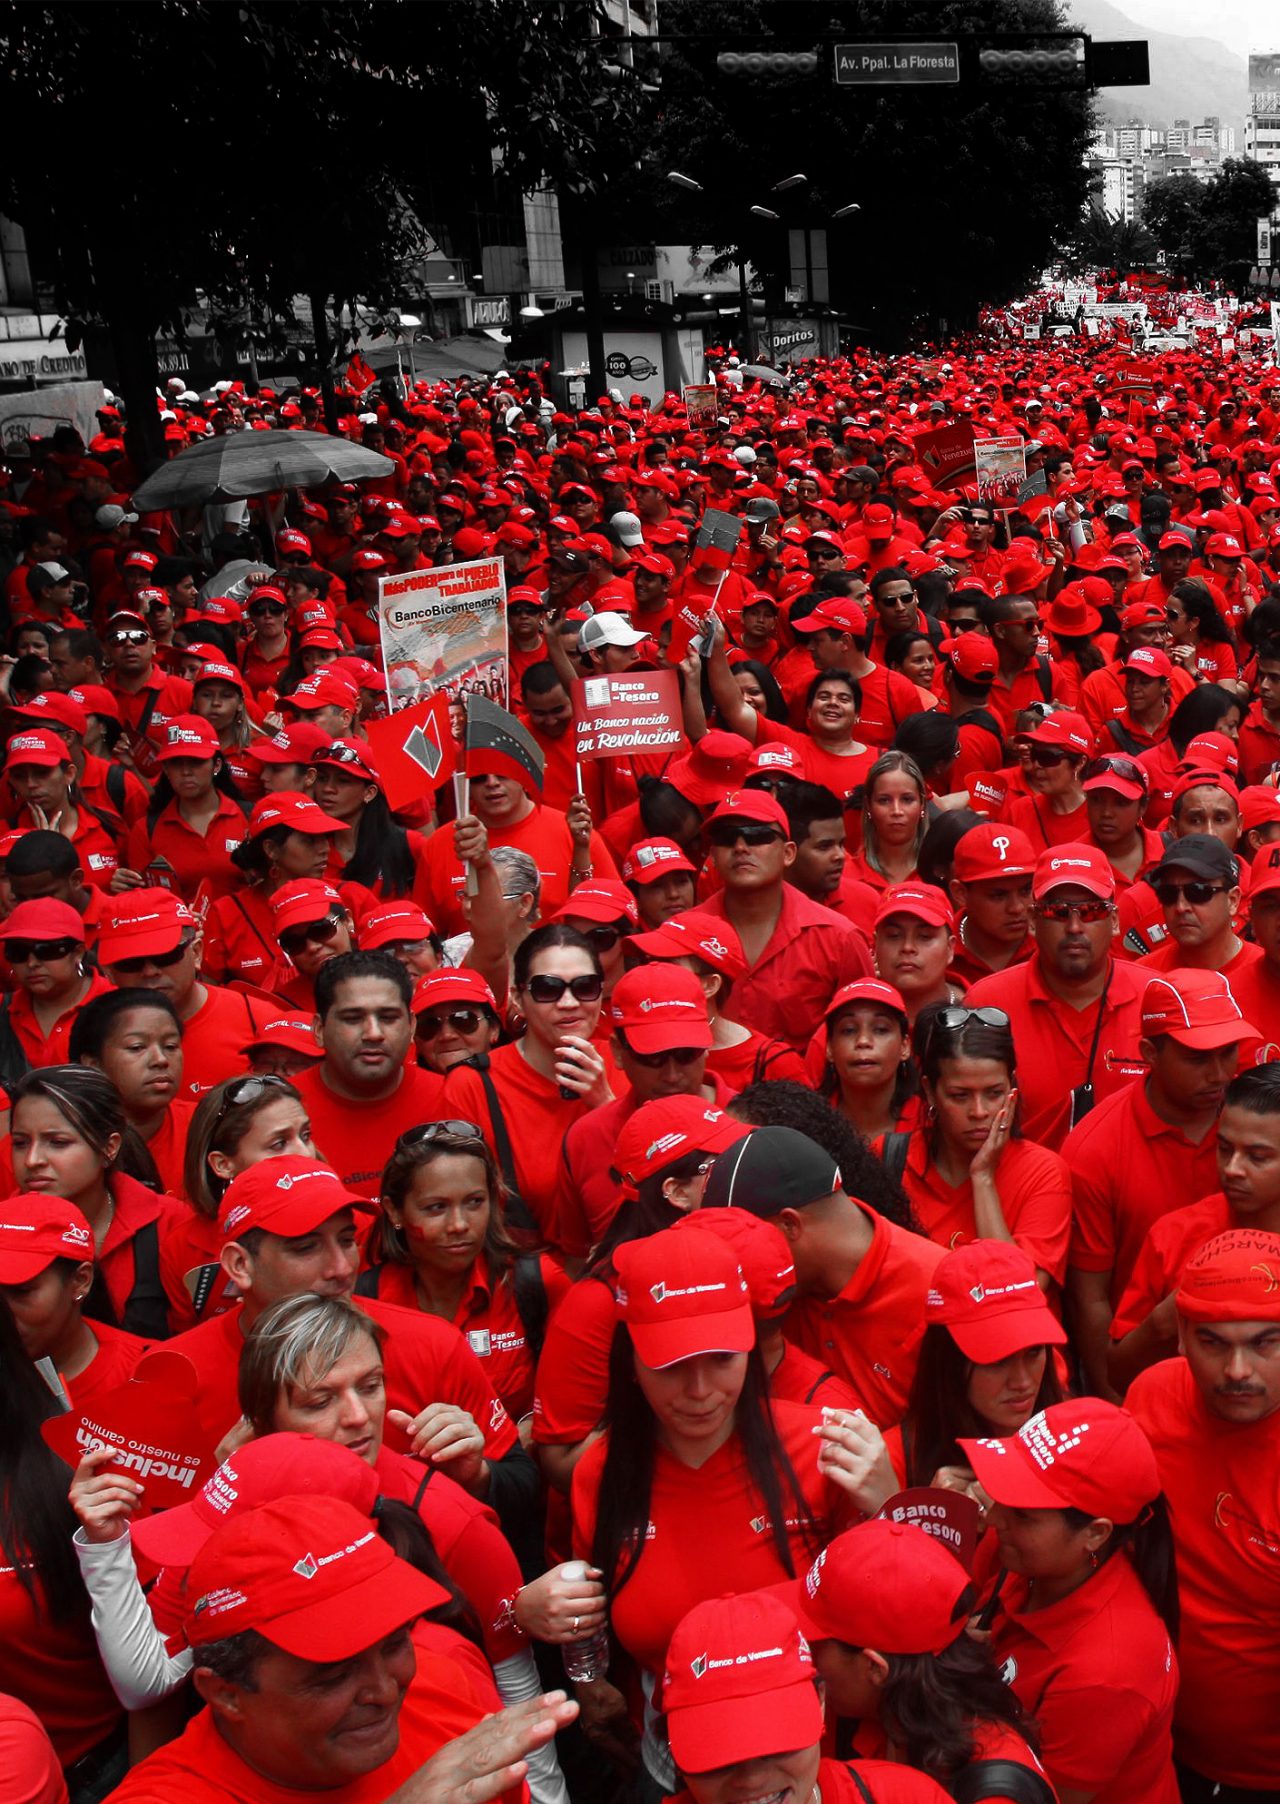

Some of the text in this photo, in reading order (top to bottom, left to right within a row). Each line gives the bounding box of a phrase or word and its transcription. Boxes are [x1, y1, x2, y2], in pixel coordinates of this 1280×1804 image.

[840, 54, 955, 71] Av. Ppal. La Floresta
[773, 329, 814, 347] Doritos
[395, 595, 501, 622] BancoBicentenario
[611, 682, 645, 691] Banco
[576, 713, 669, 733] Un Banco nacido
[576, 728, 681, 753] en Revolución
[992, 836, 1010, 860] P
[491, 1331, 515, 1341] Banco
[496, 1337, 526, 1350] Tesoro
[81, 1417, 201, 1466] camino nuestro es
[892, 1503, 947, 1523] Banco
[318, 1550, 345, 1566] Banco
[345, 1545, 357, 1555] de
[708, 1647, 783, 1668] Banco de Venezuela
